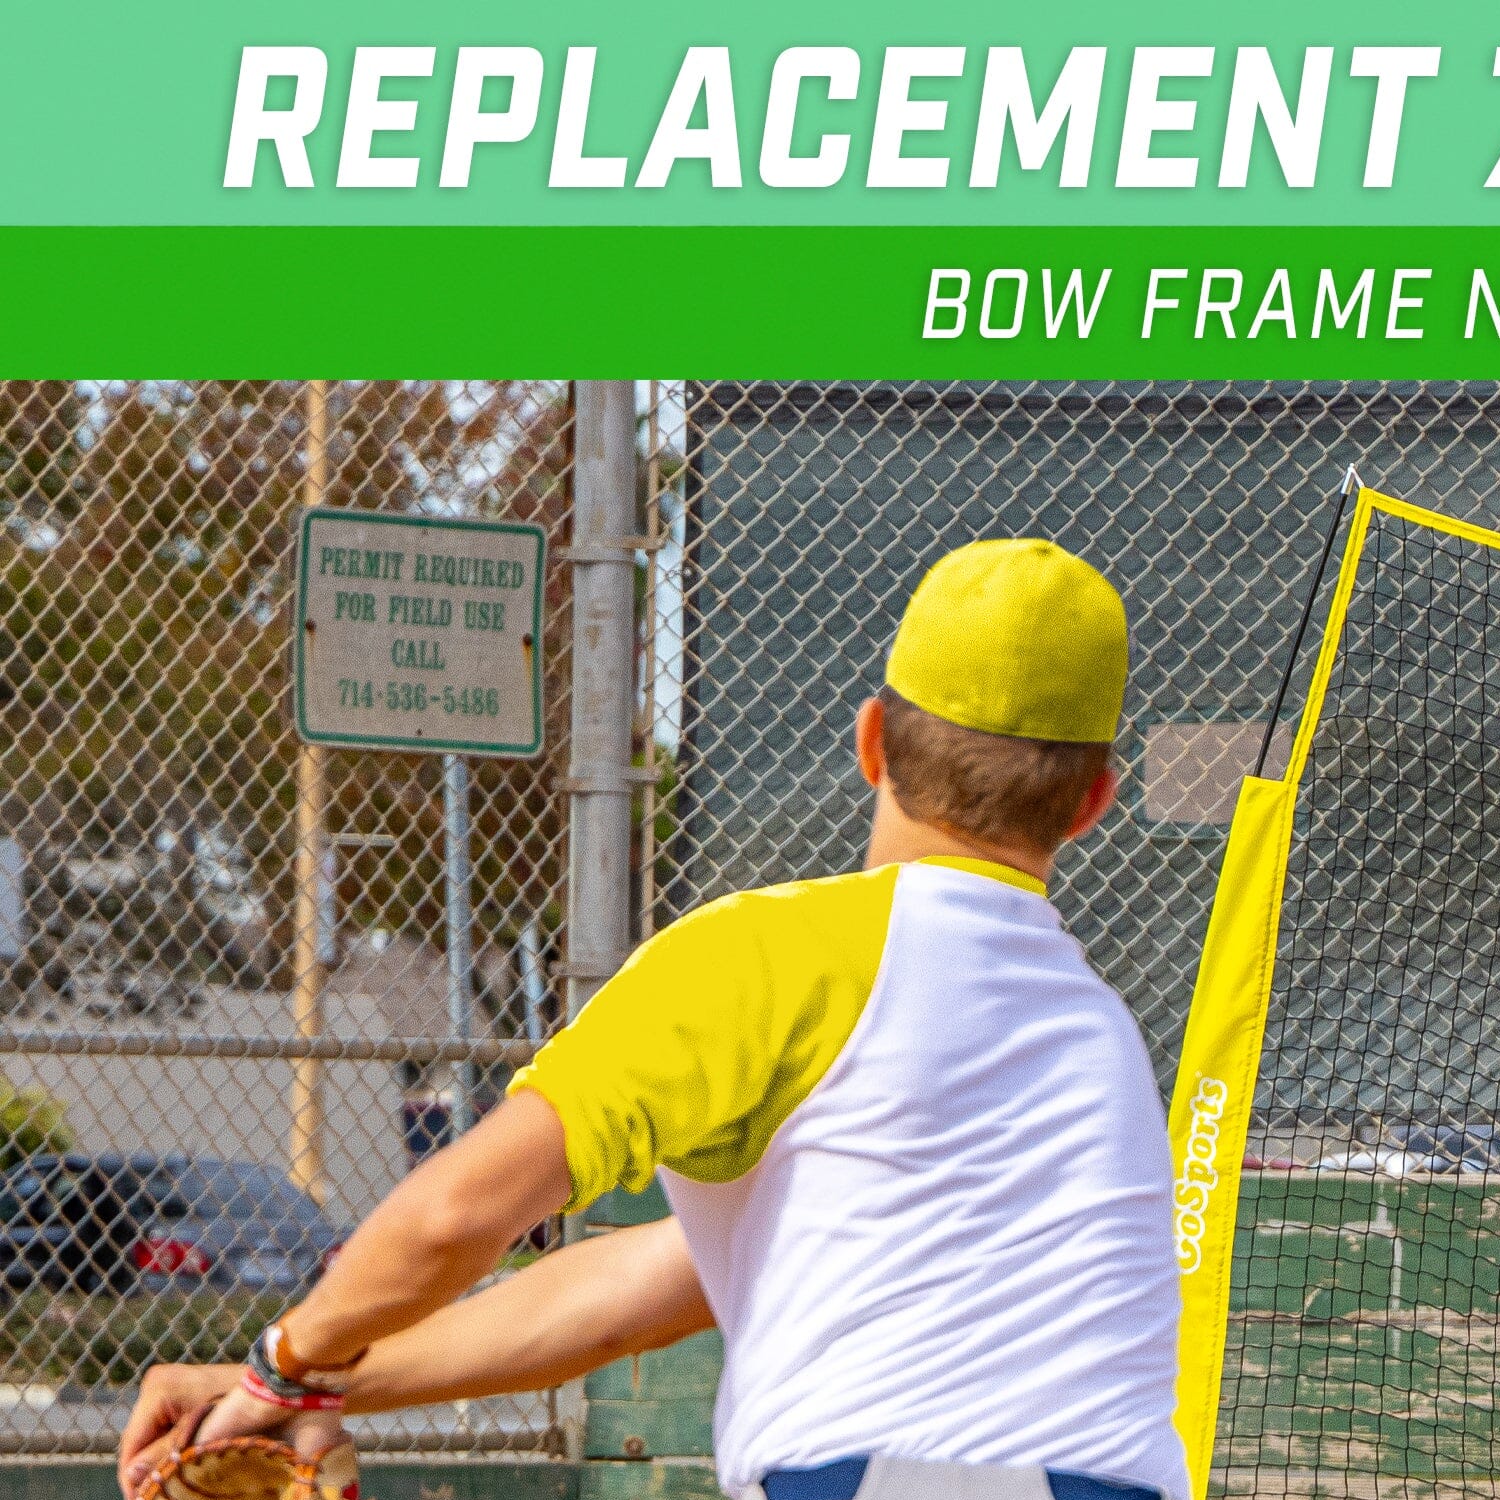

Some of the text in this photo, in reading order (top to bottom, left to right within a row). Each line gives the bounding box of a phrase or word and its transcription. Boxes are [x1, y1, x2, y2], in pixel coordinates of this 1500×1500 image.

[320, 547, 524, 589] PERMIT REQUIRED
[334, 591, 505, 631] FOR FIELD USE
[391, 639, 445, 671] CALL
